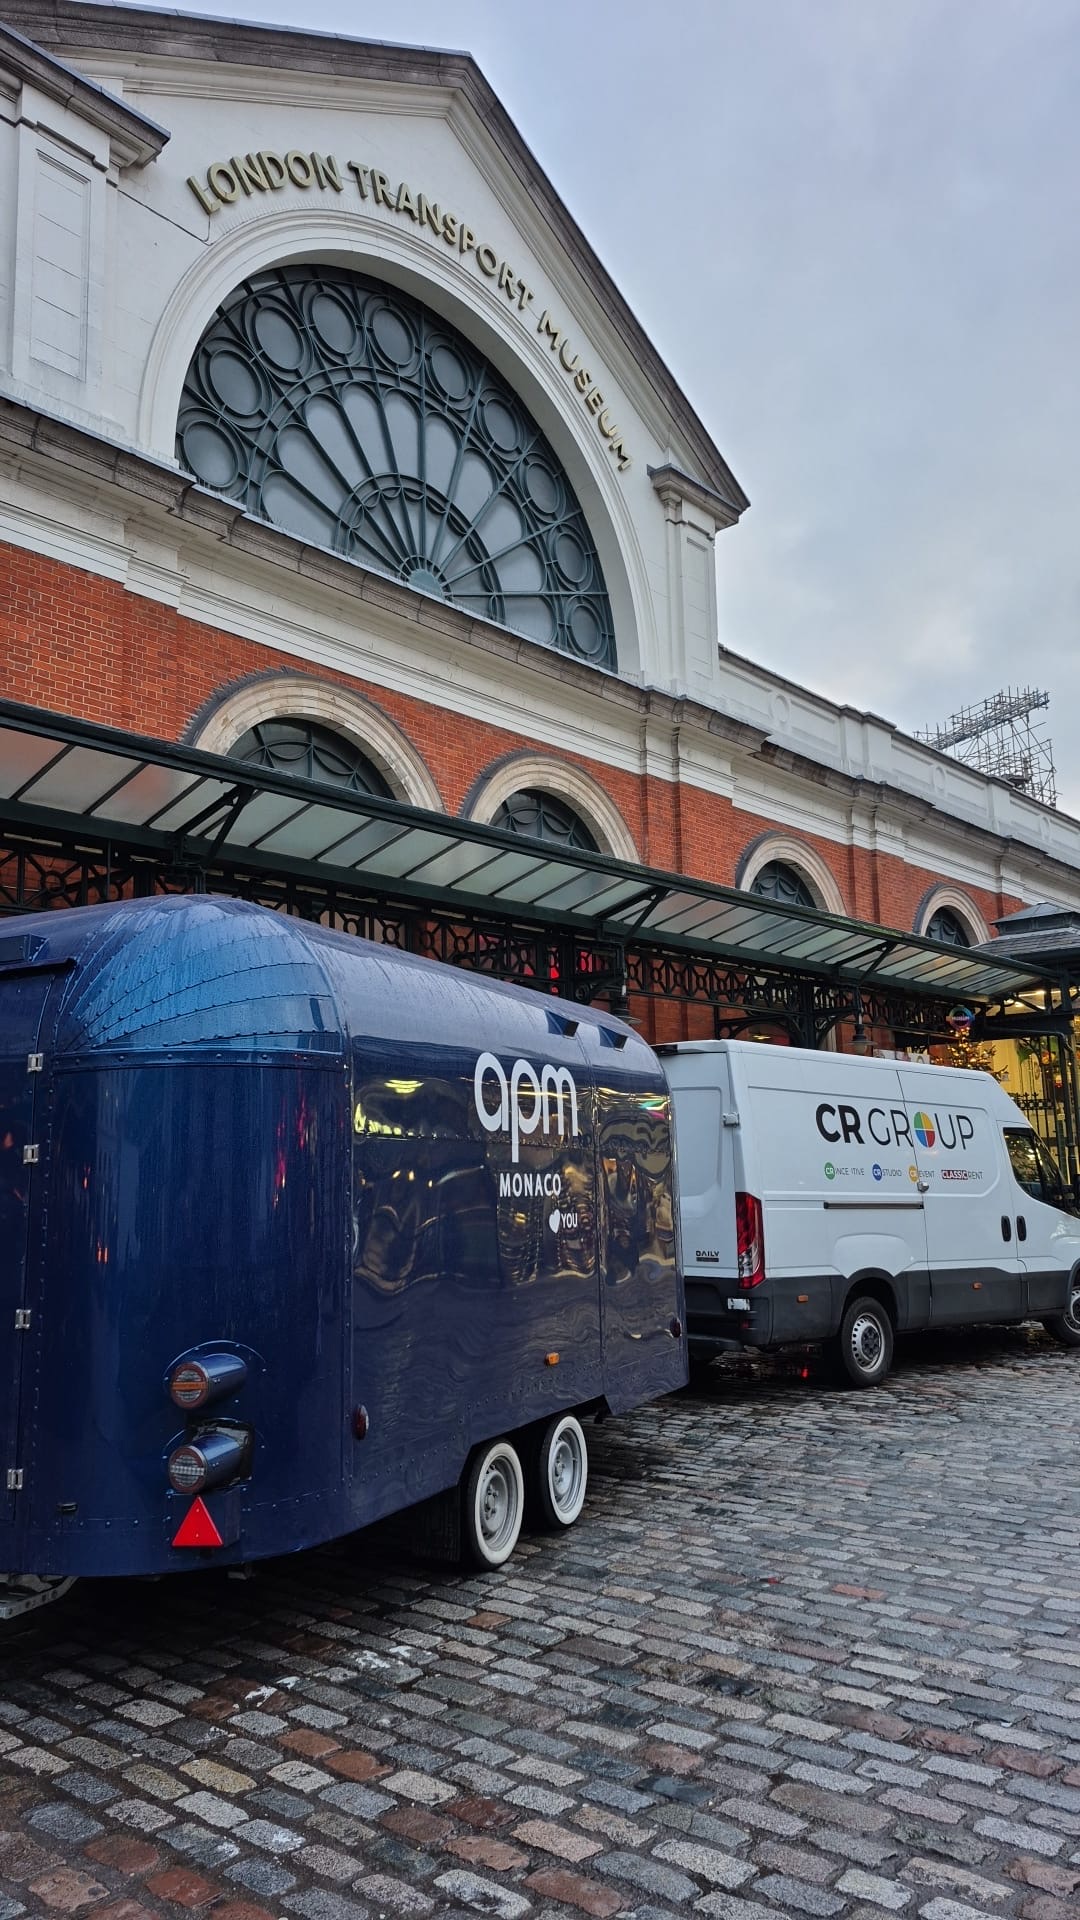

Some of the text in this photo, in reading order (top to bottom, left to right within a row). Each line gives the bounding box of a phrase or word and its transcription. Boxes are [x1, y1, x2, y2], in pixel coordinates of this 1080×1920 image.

[186, 150, 633, 471] LONDON TRANSPORT MUSEUM
[474, 1052, 578, 1163] apm
[499, 1173, 562, 1197] MONACO
[561, 1212, 578, 1228] YOU
